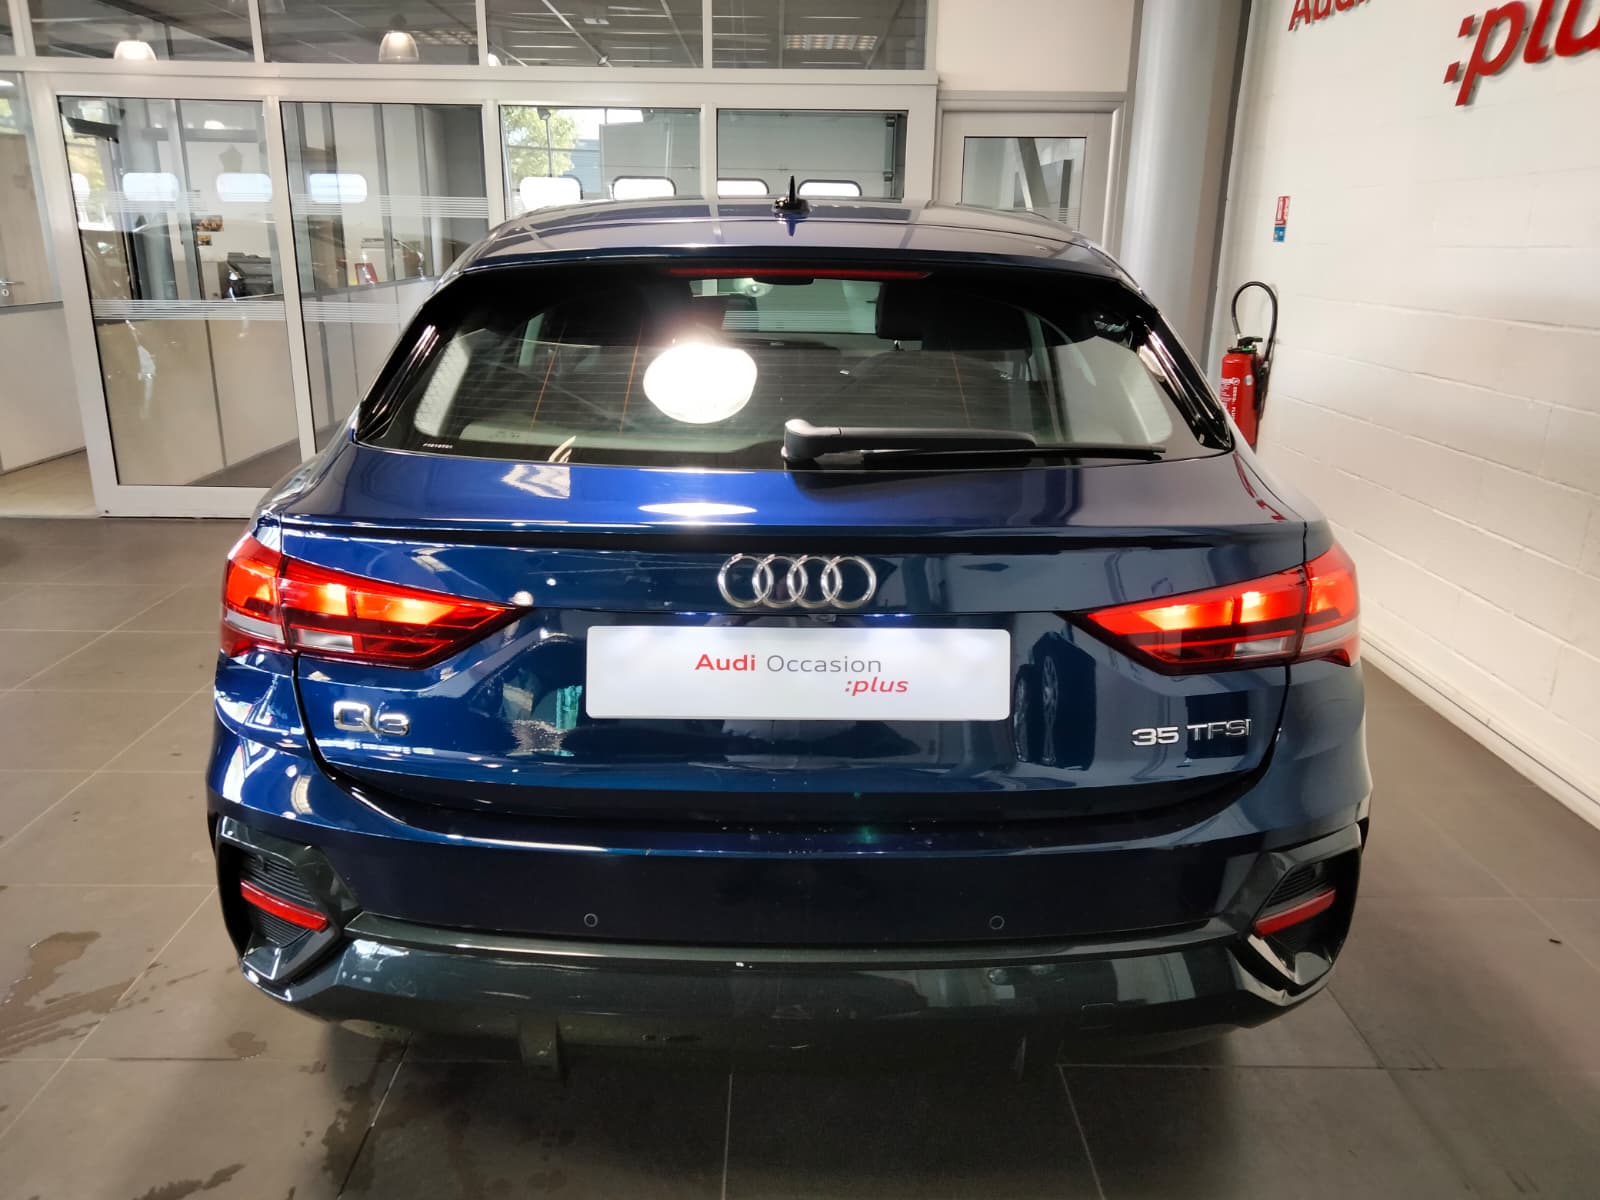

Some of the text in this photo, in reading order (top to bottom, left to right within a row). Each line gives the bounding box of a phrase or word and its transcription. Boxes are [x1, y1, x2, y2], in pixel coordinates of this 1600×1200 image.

[1288, 0, 1365, 31] Au
[695, 653, 882, 673] Audi Occasion
[844, 676, 909, 697] :plus
[333, 701, 409, 736] Q3
[1131, 718, 1252, 746] 35 TFSI
